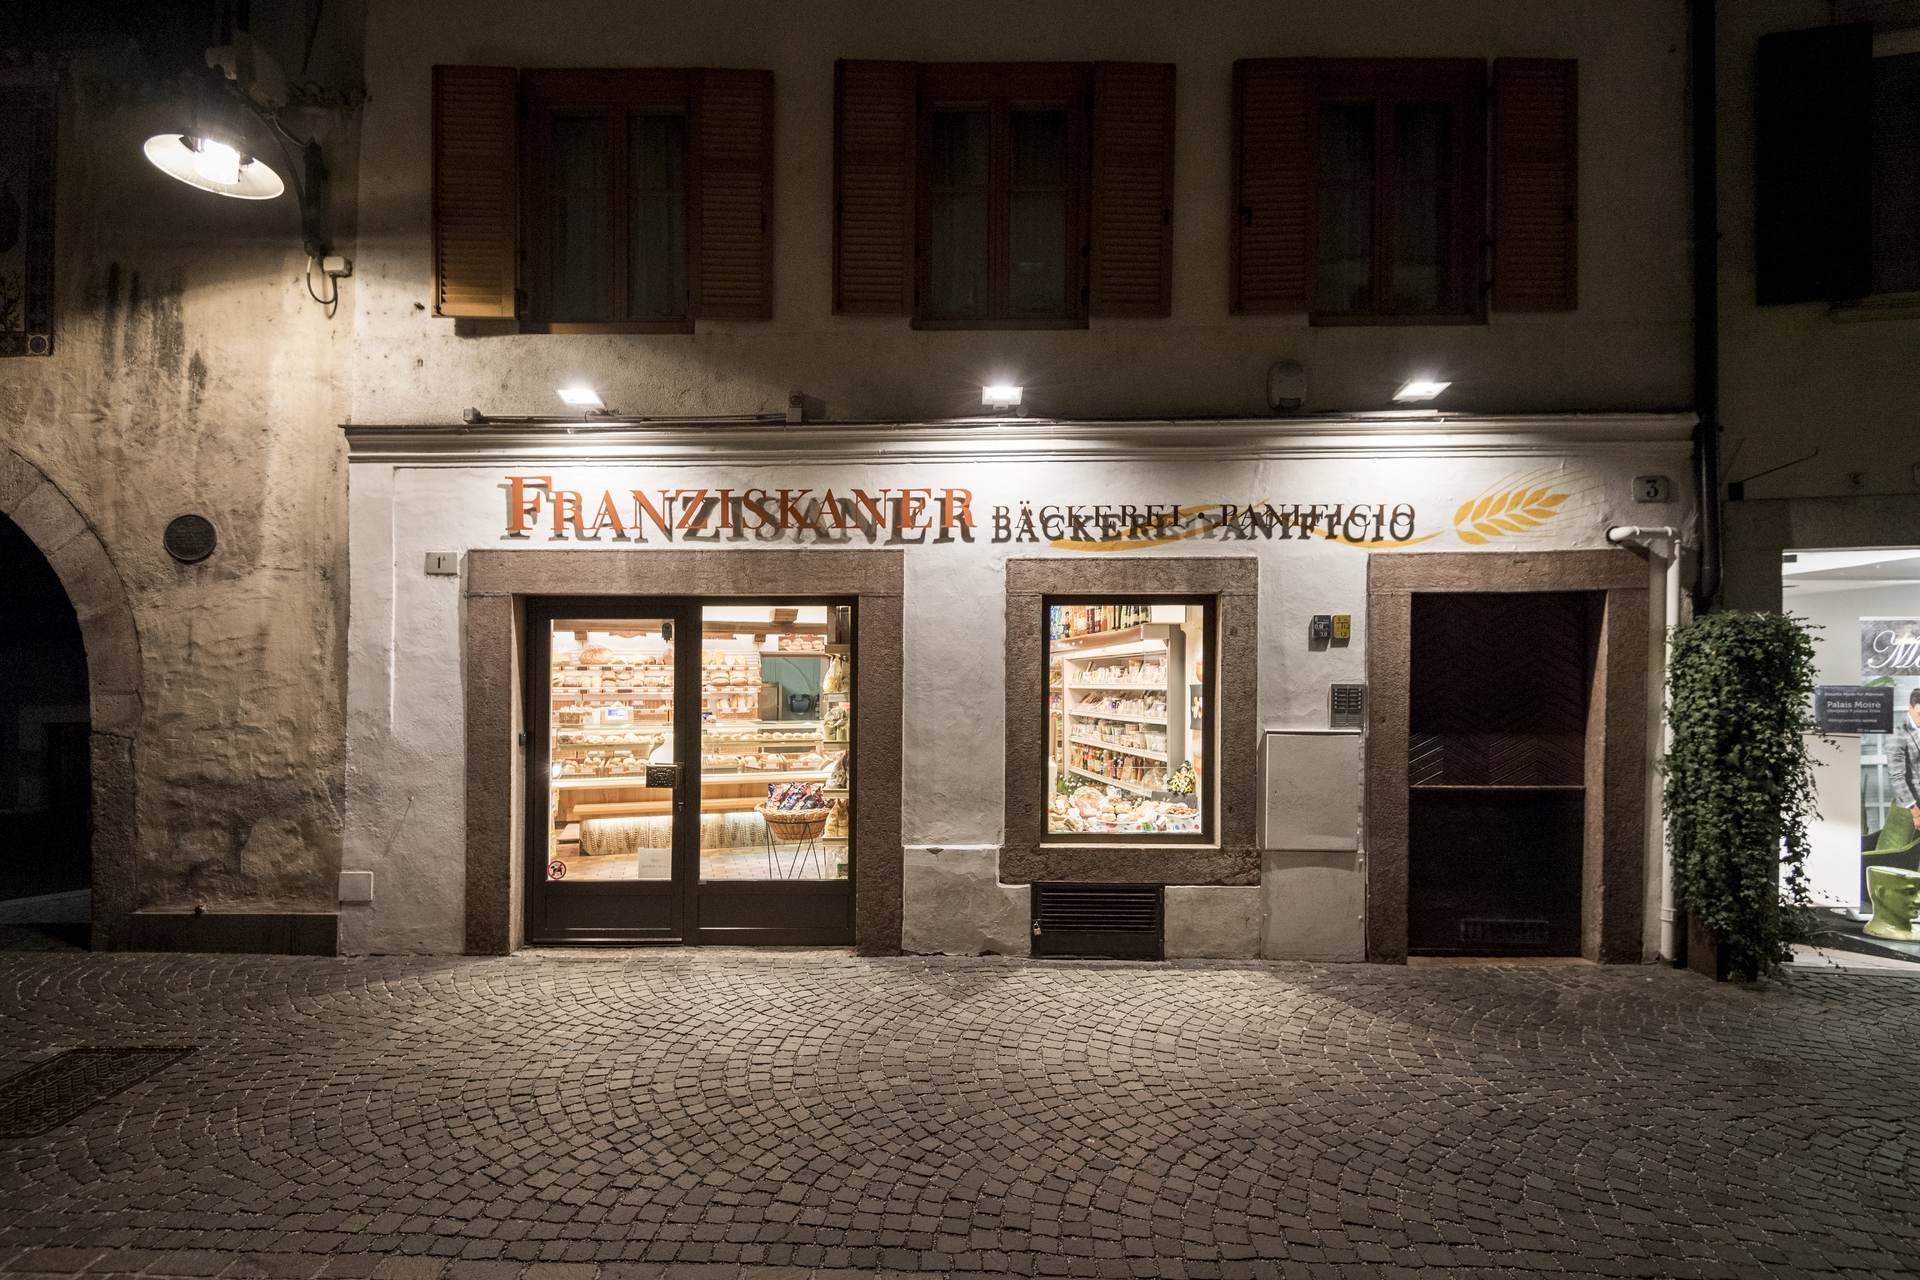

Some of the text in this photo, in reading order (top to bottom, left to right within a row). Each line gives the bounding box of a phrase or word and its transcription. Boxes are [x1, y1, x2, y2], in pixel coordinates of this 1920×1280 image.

[1646, 480, 1659, 498] 3
[505, 476, 1416, 531] FRANZISKANER BÄCKEREI PANIFICIO
[1826, 700, 1852, 709] Palais
